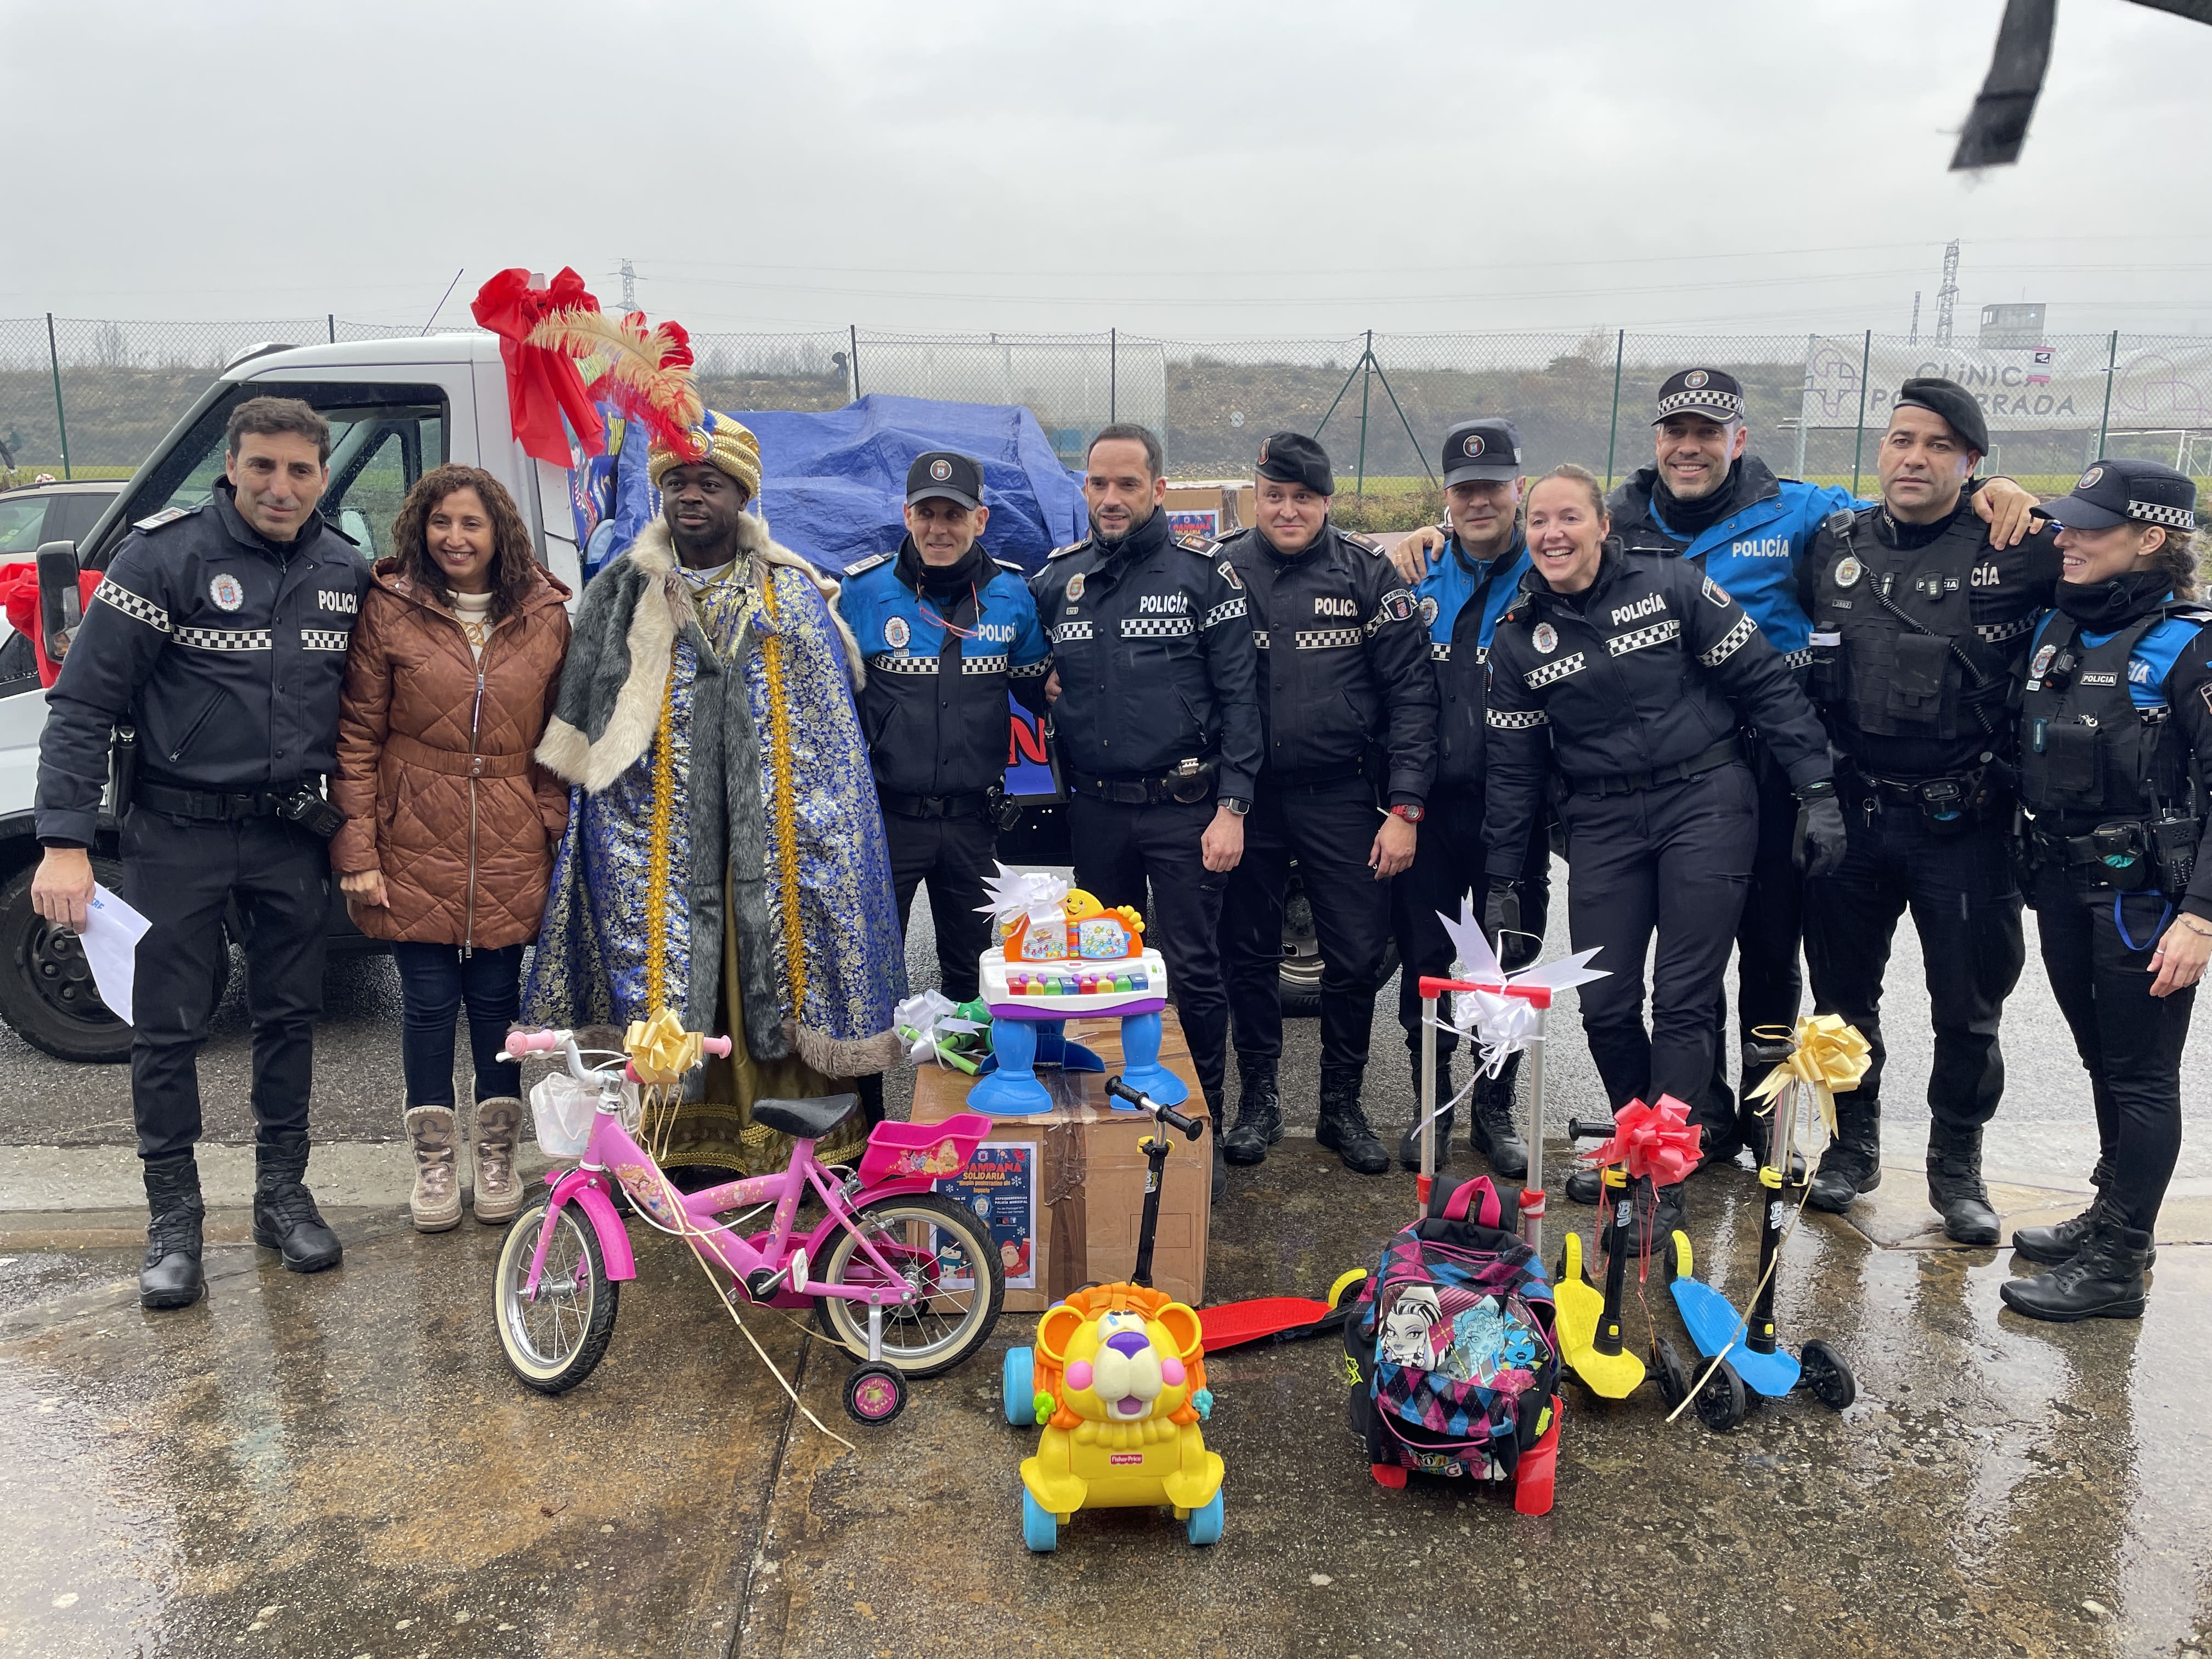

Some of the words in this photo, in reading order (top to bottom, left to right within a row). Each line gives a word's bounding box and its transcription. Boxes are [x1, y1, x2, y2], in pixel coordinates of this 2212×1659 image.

[1915, 362, 2045, 387] CLÍNIC
[1733, 534, 1789, 558] POLICÍA
[1139, 591, 1188, 613] POLICÍA
[1611, 592, 1667, 626] POLICÍA
[2083, 675, 2114, 683] POLICIA
[965, 1160, 1022, 1172] AMPAÑA
